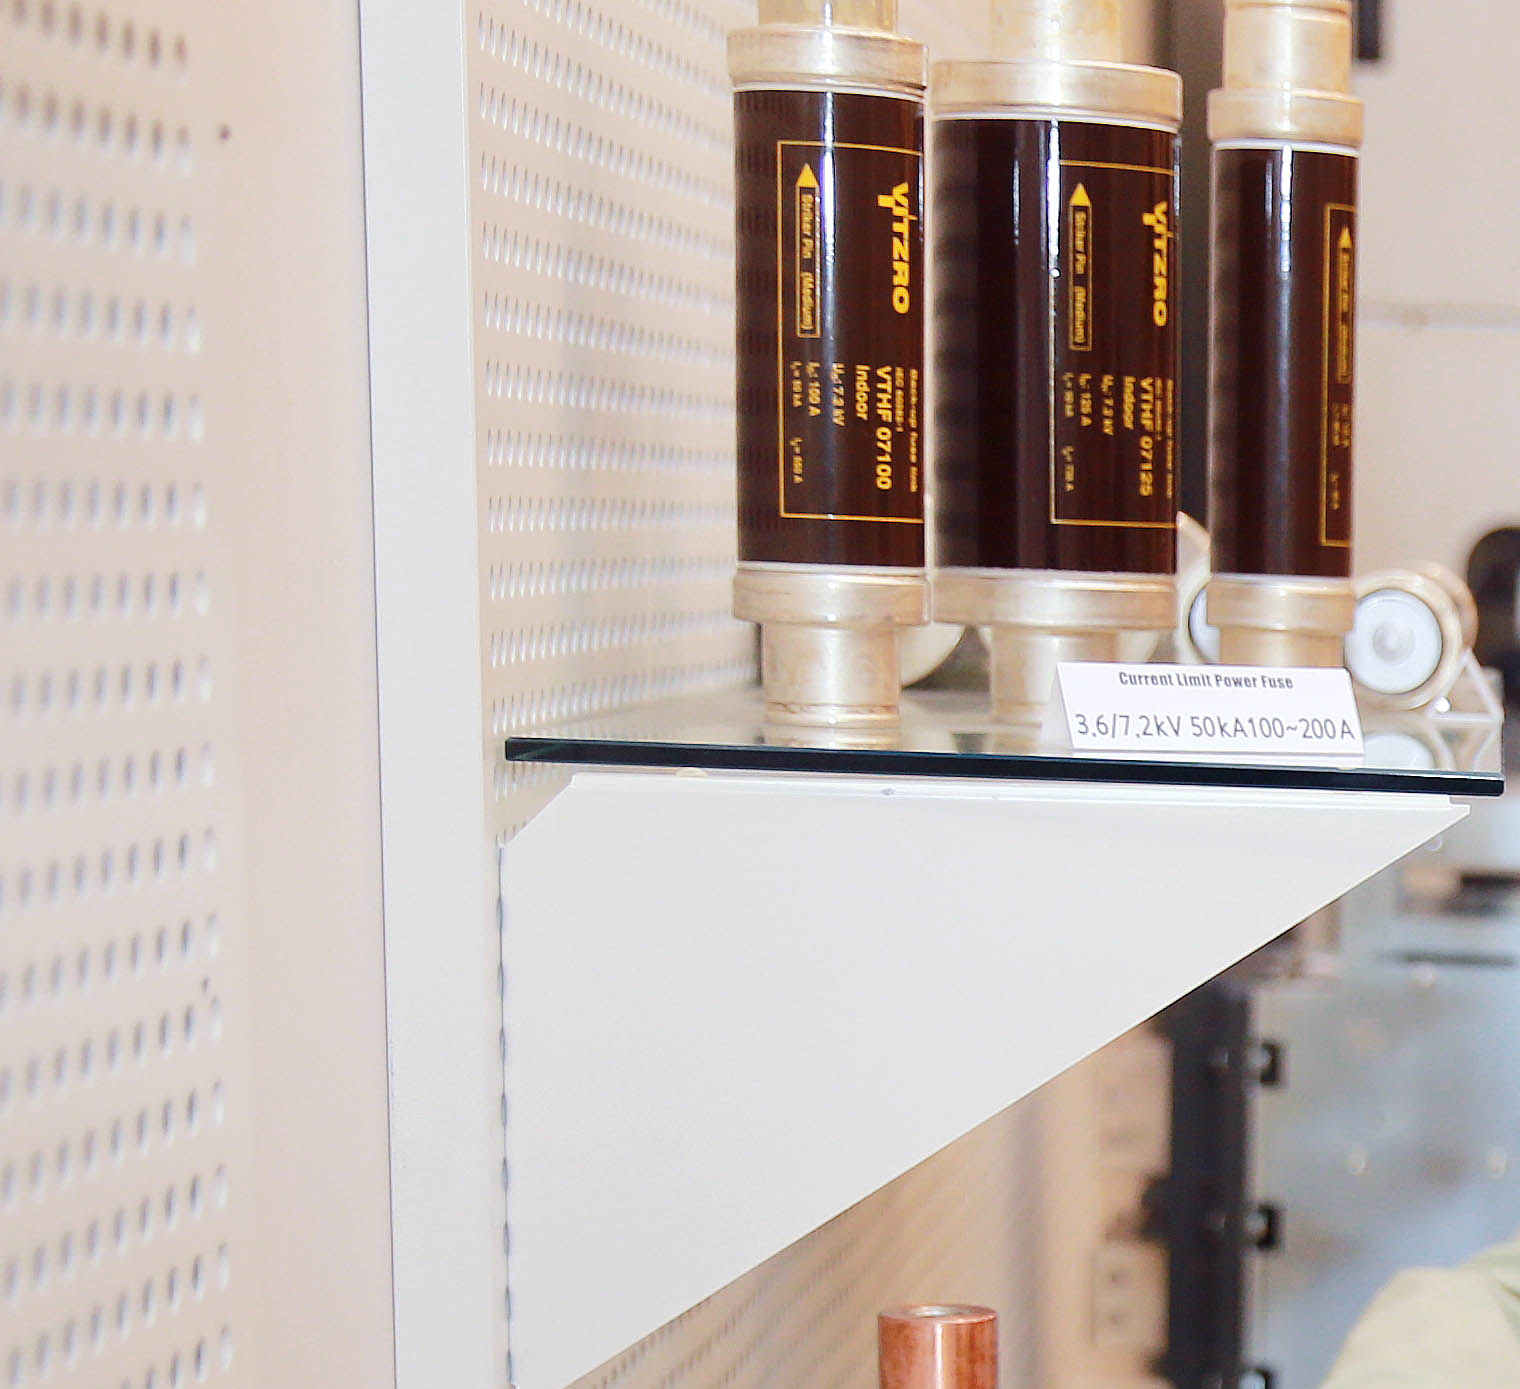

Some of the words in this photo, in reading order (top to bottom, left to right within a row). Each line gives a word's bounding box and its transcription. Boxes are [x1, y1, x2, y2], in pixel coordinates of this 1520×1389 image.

[801, 238, 814, 259] Pin
[877, 182, 919, 314] VITZRO
[1142, 201, 1175, 327] VITZRO
[808, 381, 821, 404] 100
[808, 406, 821, 417] A
[855, 364, 871, 421] Indoor
[876, 366, 893, 423] VTHF
[1123, 375, 1137, 430] Indoor
[1140, 376, 1154, 432] VTHF
[876, 427, 893, 491] 07100
[1139, 435, 1154, 497] 07125
[1118, 671, 1174, 688] Current
[1177, 672, 1214, 688] Limit
[1215, 674, 1258, 689] Power
[1261, 674, 1294, 690] Fuse
